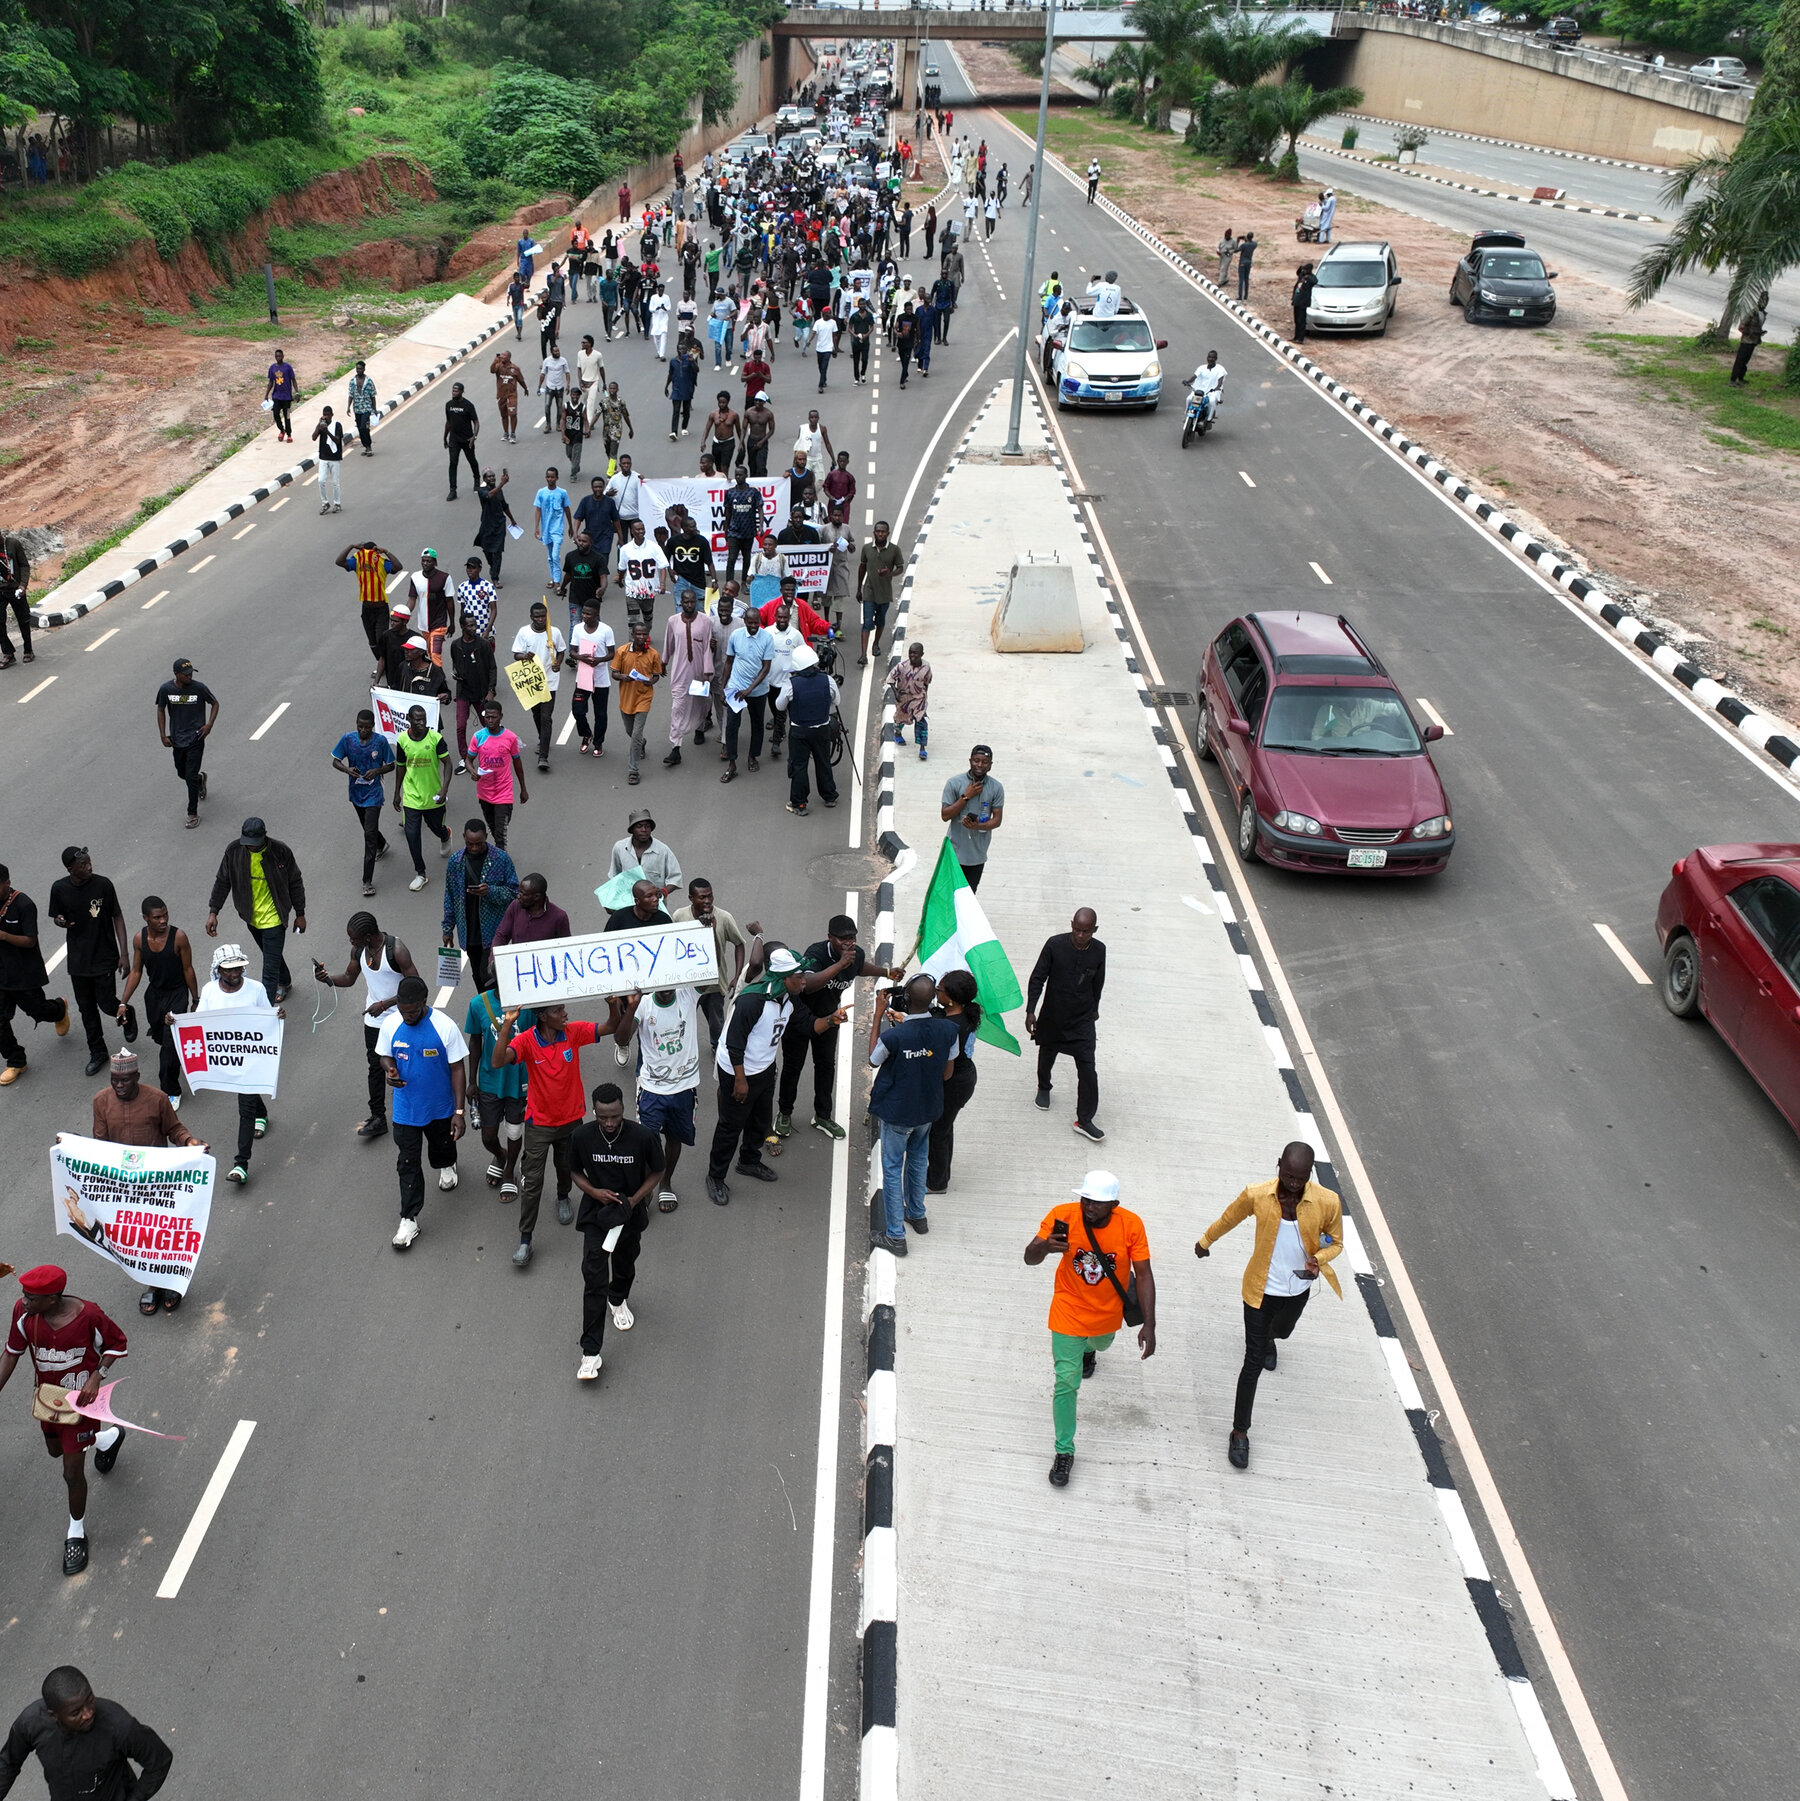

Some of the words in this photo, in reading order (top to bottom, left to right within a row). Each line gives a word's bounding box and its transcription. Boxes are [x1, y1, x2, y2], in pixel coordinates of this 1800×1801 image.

[515, 936, 665, 992] HUNGRY
[206, 1031, 264, 1042] ENDBAD
[207, 1044, 279, 1056] GOVERNANCE
[666, 1039, 683, 1056] 63
[208, 1055, 244, 1067] NOW
[592, 1153, 634, 1164] UNLIMITED
[68, 1169, 82, 1182] THE
[83, 1174, 117, 1187] POWER
[118, 1181, 130, 1190] OF
[150, 1183, 183, 1192] PEOPLE
[184, 1184, 194, 1193] IS
[81, 1184, 130, 1196] STRONGER
[132, 1190, 156, 1198] THAN
[158, 1190, 175, 1200] THE
[112, 1194, 122, 1203] IN
[124, 1195, 141, 1204] THE
[142, 1197, 176, 1209] POWER
[115, 1209, 194, 1231] ERADICATE
[104, 1223, 202, 1254] HUNGER
[140, 1250, 160, 1260] OUR
[161, 1252, 193, 1263] NATION
[137, 1261, 148, 1272] IS
[148, 1263, 193, 1280] ENOUGH!!!
